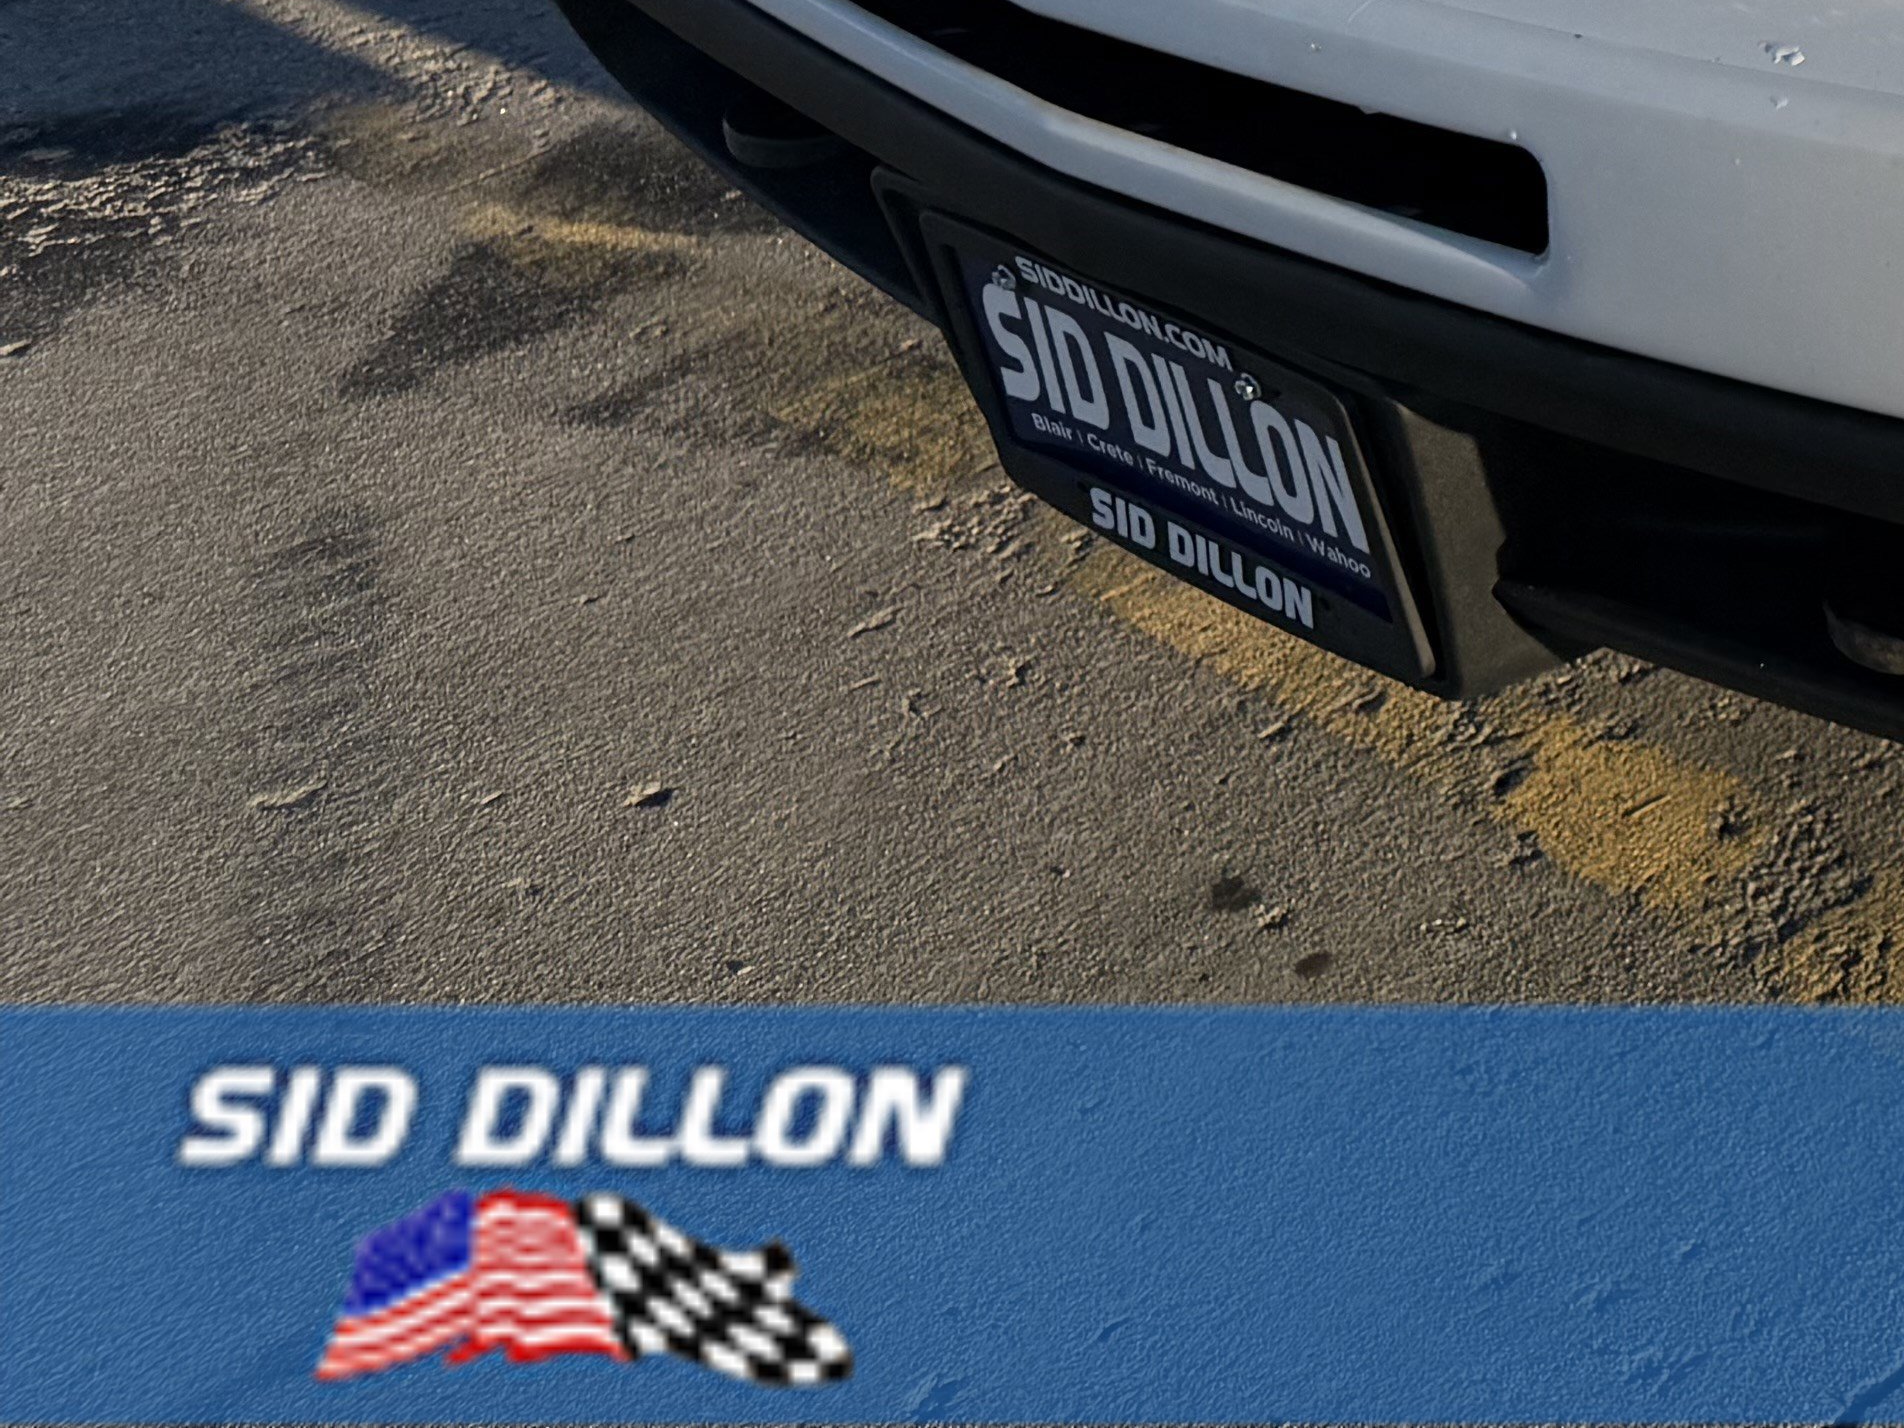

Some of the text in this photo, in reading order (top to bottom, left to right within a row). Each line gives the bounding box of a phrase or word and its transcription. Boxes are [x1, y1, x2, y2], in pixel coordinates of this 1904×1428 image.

[1013, 254, 1234, 372] SIDDILLON.COM
[982, 282, 1370, 555] SID DILLON
[1032, 412, 1372, 579] Blair Crete Fremont Lincoln Wahoo
[1088, 485, 1315, 631] SID DILLON
